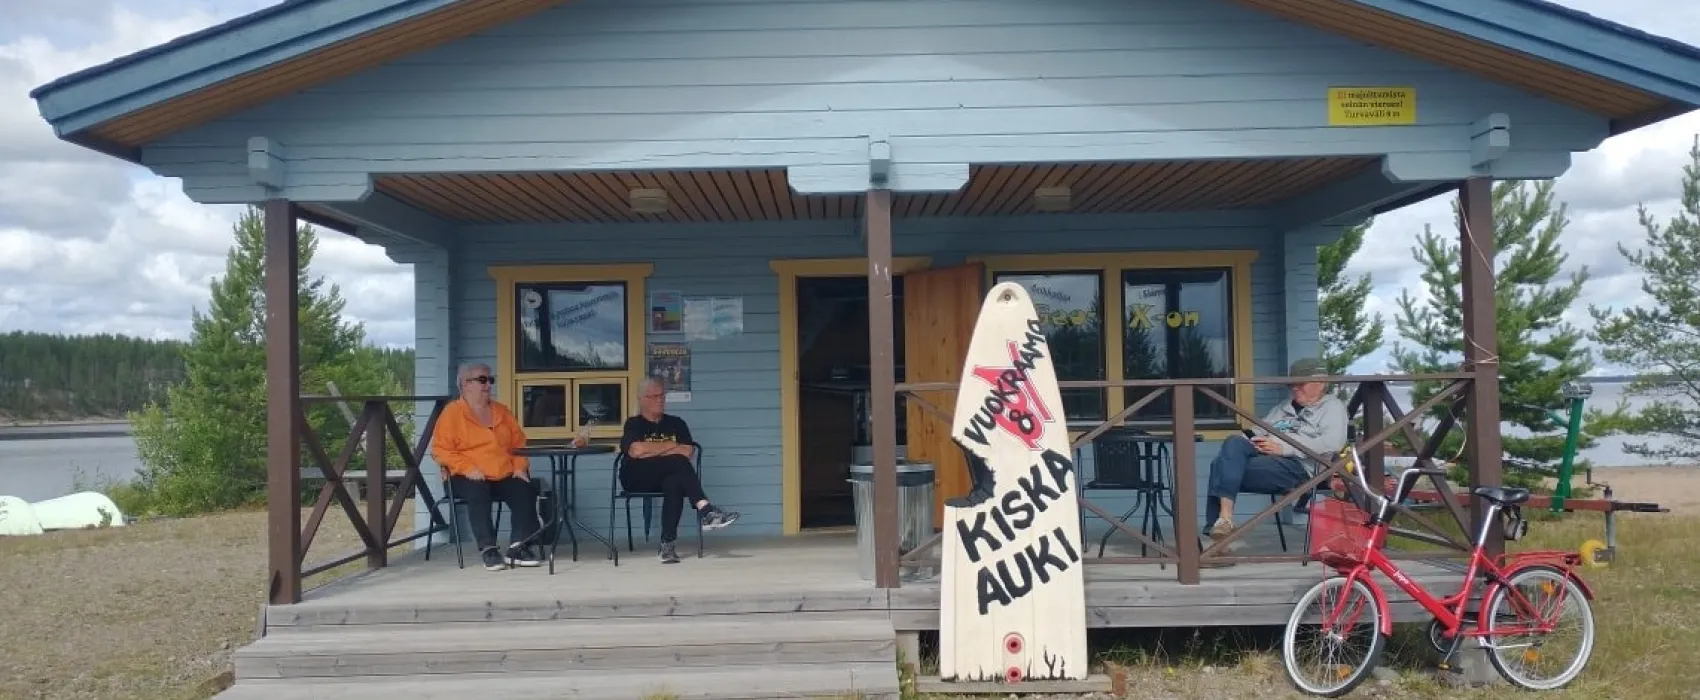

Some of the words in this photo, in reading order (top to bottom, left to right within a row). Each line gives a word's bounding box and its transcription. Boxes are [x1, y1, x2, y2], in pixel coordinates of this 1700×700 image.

[963, 319, 1045, 446] VUOKRAAMO
[956, 448, 1075, 563] KISKA
[976, 526, 1080, 615] AUKI
